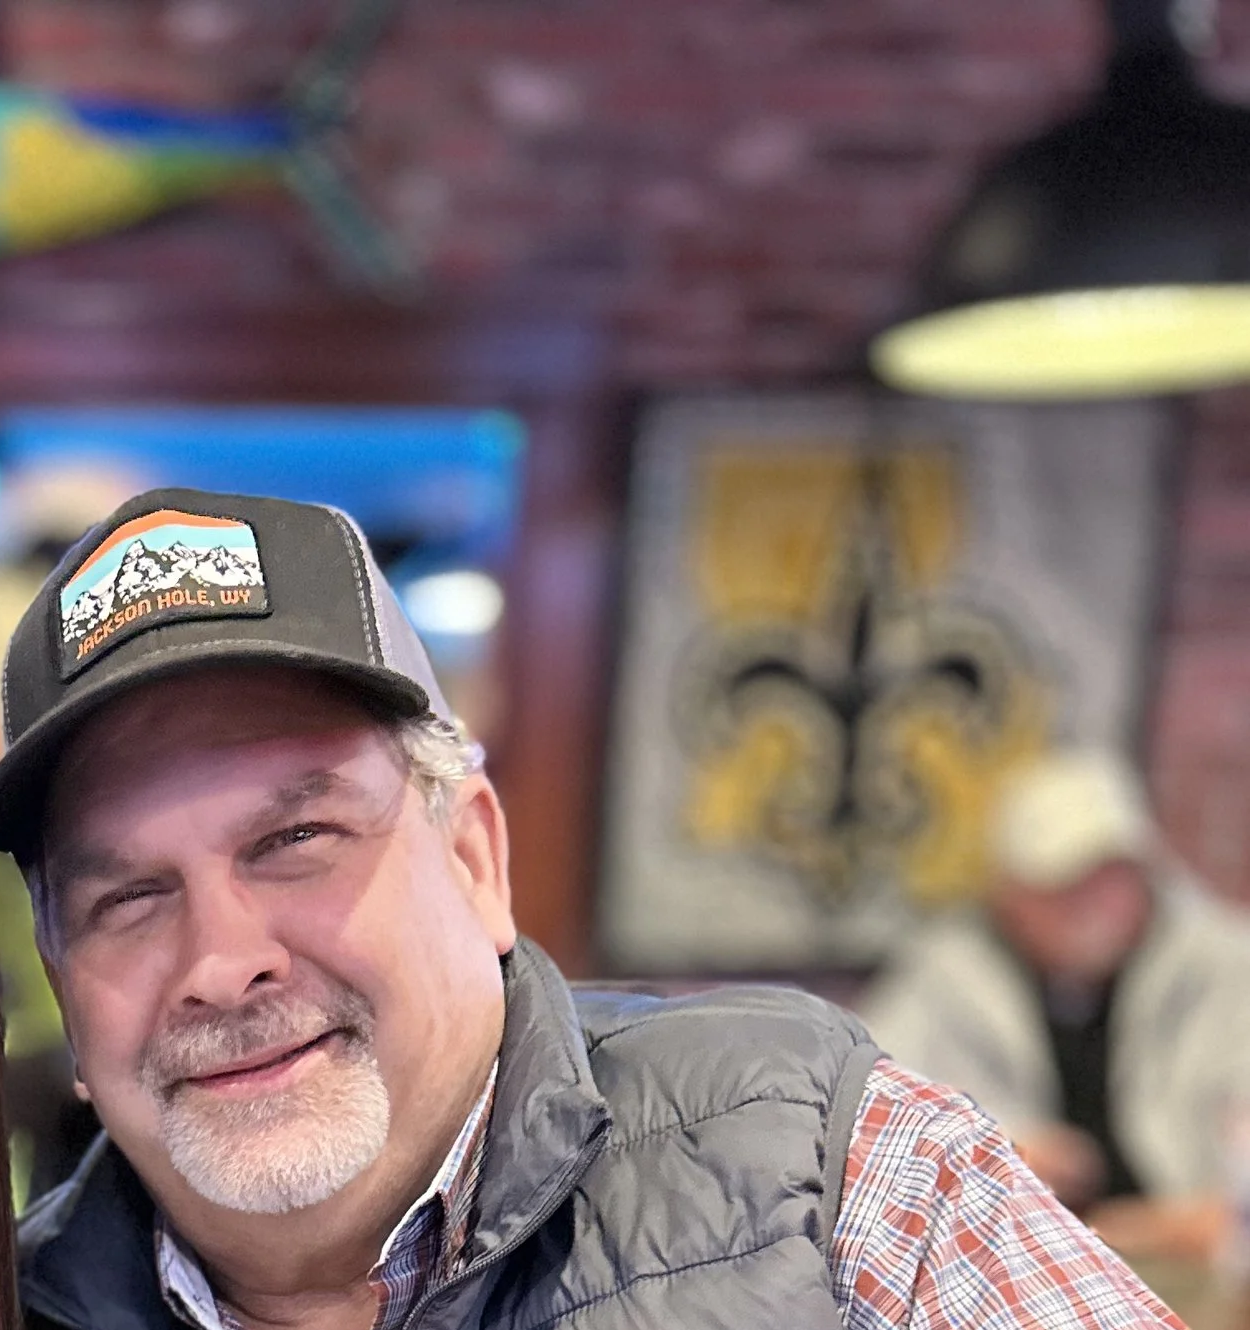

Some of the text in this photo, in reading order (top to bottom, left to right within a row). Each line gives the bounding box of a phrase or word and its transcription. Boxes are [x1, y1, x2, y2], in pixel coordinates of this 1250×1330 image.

[76, 588, 251, 659] JACKSON HOLE, WY
